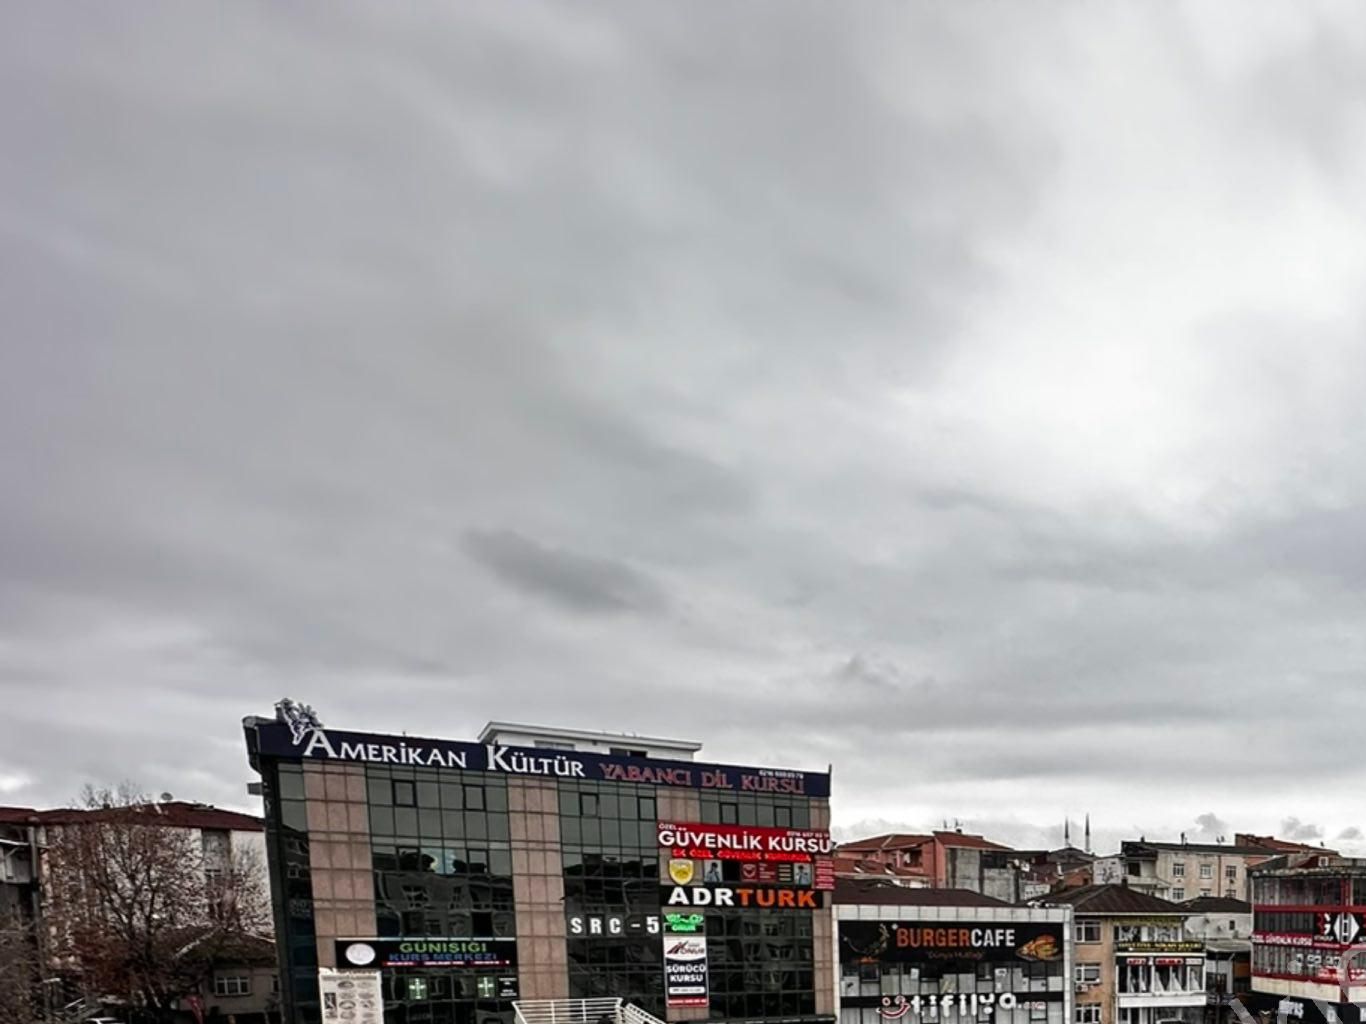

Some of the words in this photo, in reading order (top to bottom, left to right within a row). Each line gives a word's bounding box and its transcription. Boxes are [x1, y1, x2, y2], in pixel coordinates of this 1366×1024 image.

[303, 729, 467, 769] AMERİKAN
[486, 744, 586, 778] KÜLTÜR
[599, 762, 692, 786] YABANCI
[702, 769, 734, 789] DİL
[741, 775, 805, 795] KURSU
[658, 827, 764, 851] GÜVENLİK
[768, 836, 832, 853] KURSU
